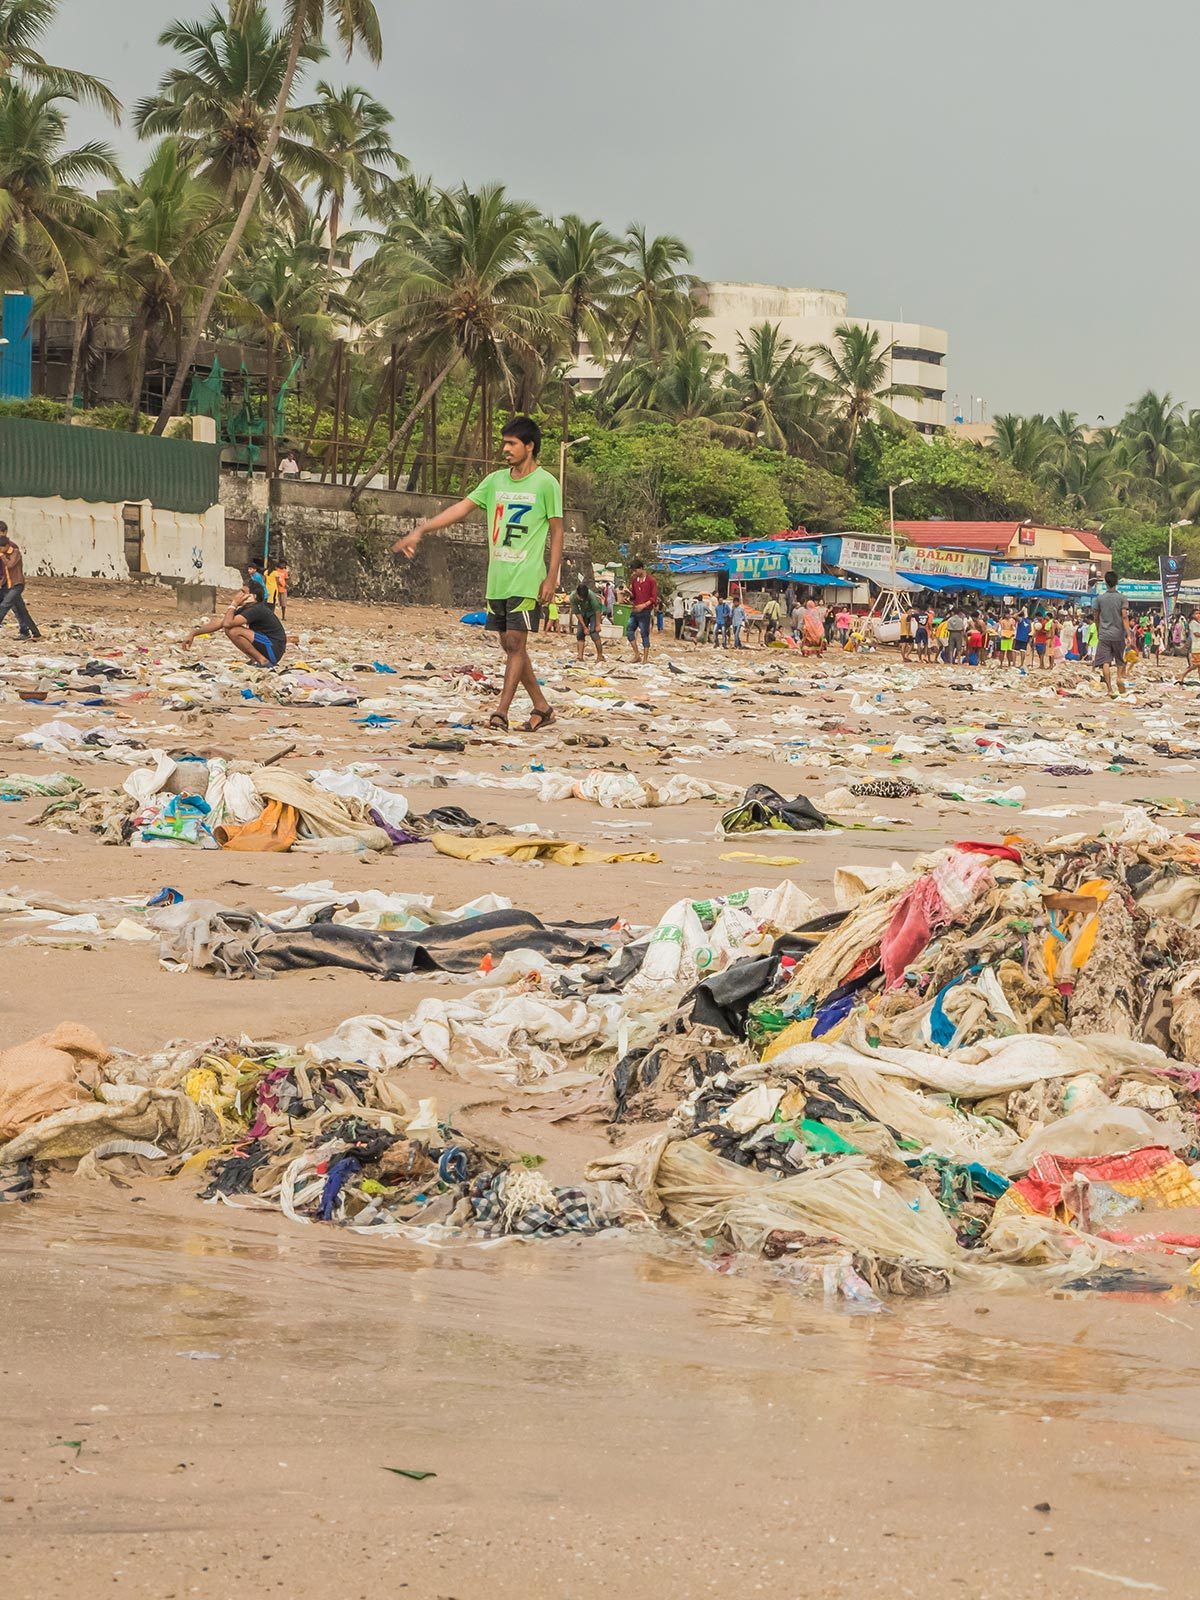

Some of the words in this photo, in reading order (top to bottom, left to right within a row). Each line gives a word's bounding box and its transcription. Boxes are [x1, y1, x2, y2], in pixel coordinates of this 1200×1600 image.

[507, 503, 533, 523] 7
[503, 524, 529, 547] F
[916, 549, 965, 563] BALAJI
[736, 557, 781, 578] BALAJI
